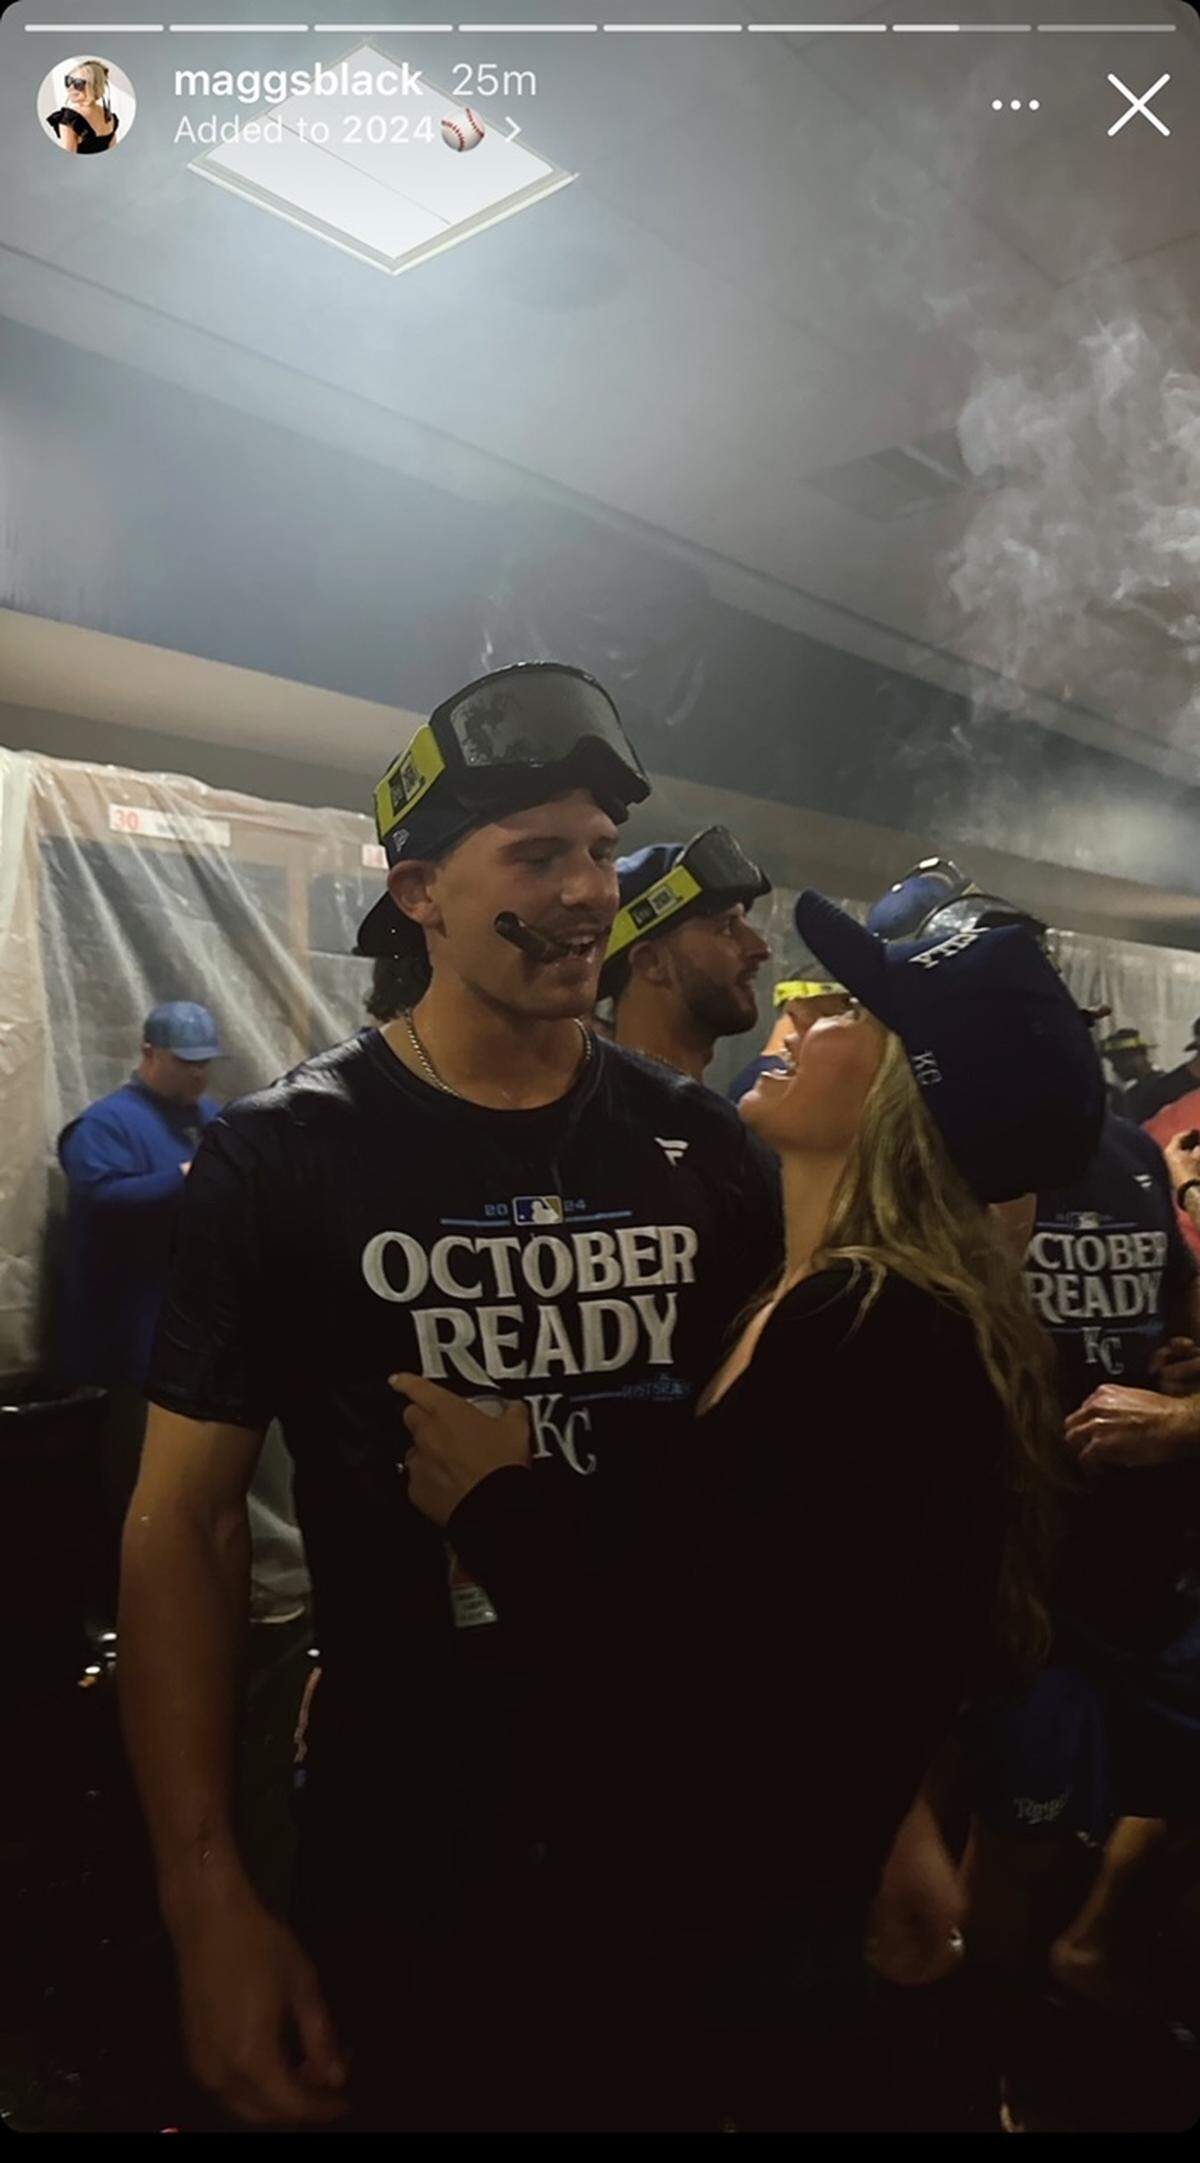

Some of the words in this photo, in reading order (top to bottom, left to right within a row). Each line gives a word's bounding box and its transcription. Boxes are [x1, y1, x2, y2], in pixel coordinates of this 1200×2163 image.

[362, 1225, 699, 1302] OCTOBER
[1021, 1270, 1164, 1325] READY
[410, 1292, 679, 1390] READY
[523, 1393, 598, 1476] KC
